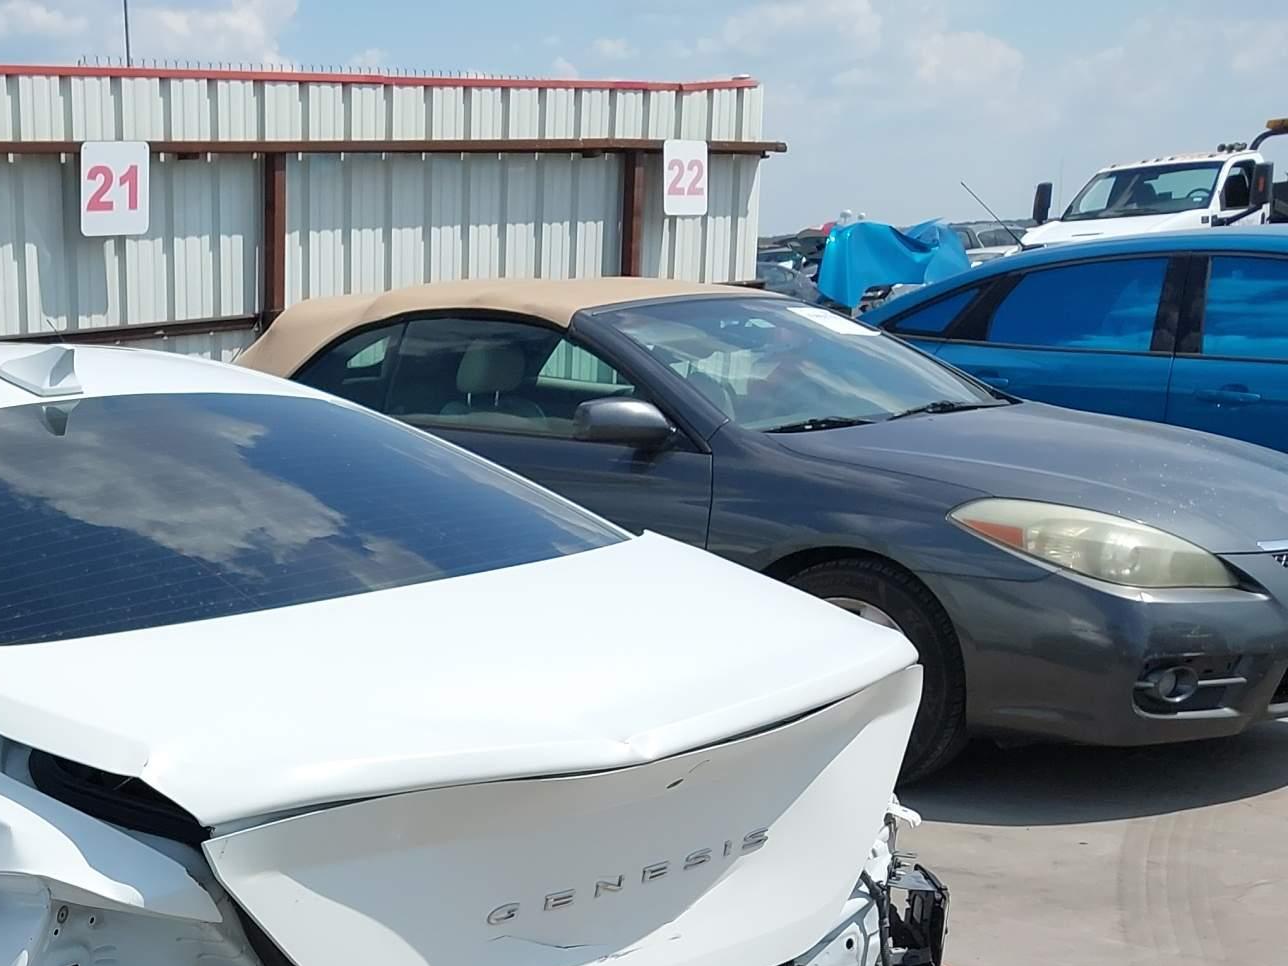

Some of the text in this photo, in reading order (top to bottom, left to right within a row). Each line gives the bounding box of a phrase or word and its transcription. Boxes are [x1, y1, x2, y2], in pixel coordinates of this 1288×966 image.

[86, 164, 139, 212] 21
[667, 158, 705, 196] 22
[486, 826, 769, 926] GENESIS
